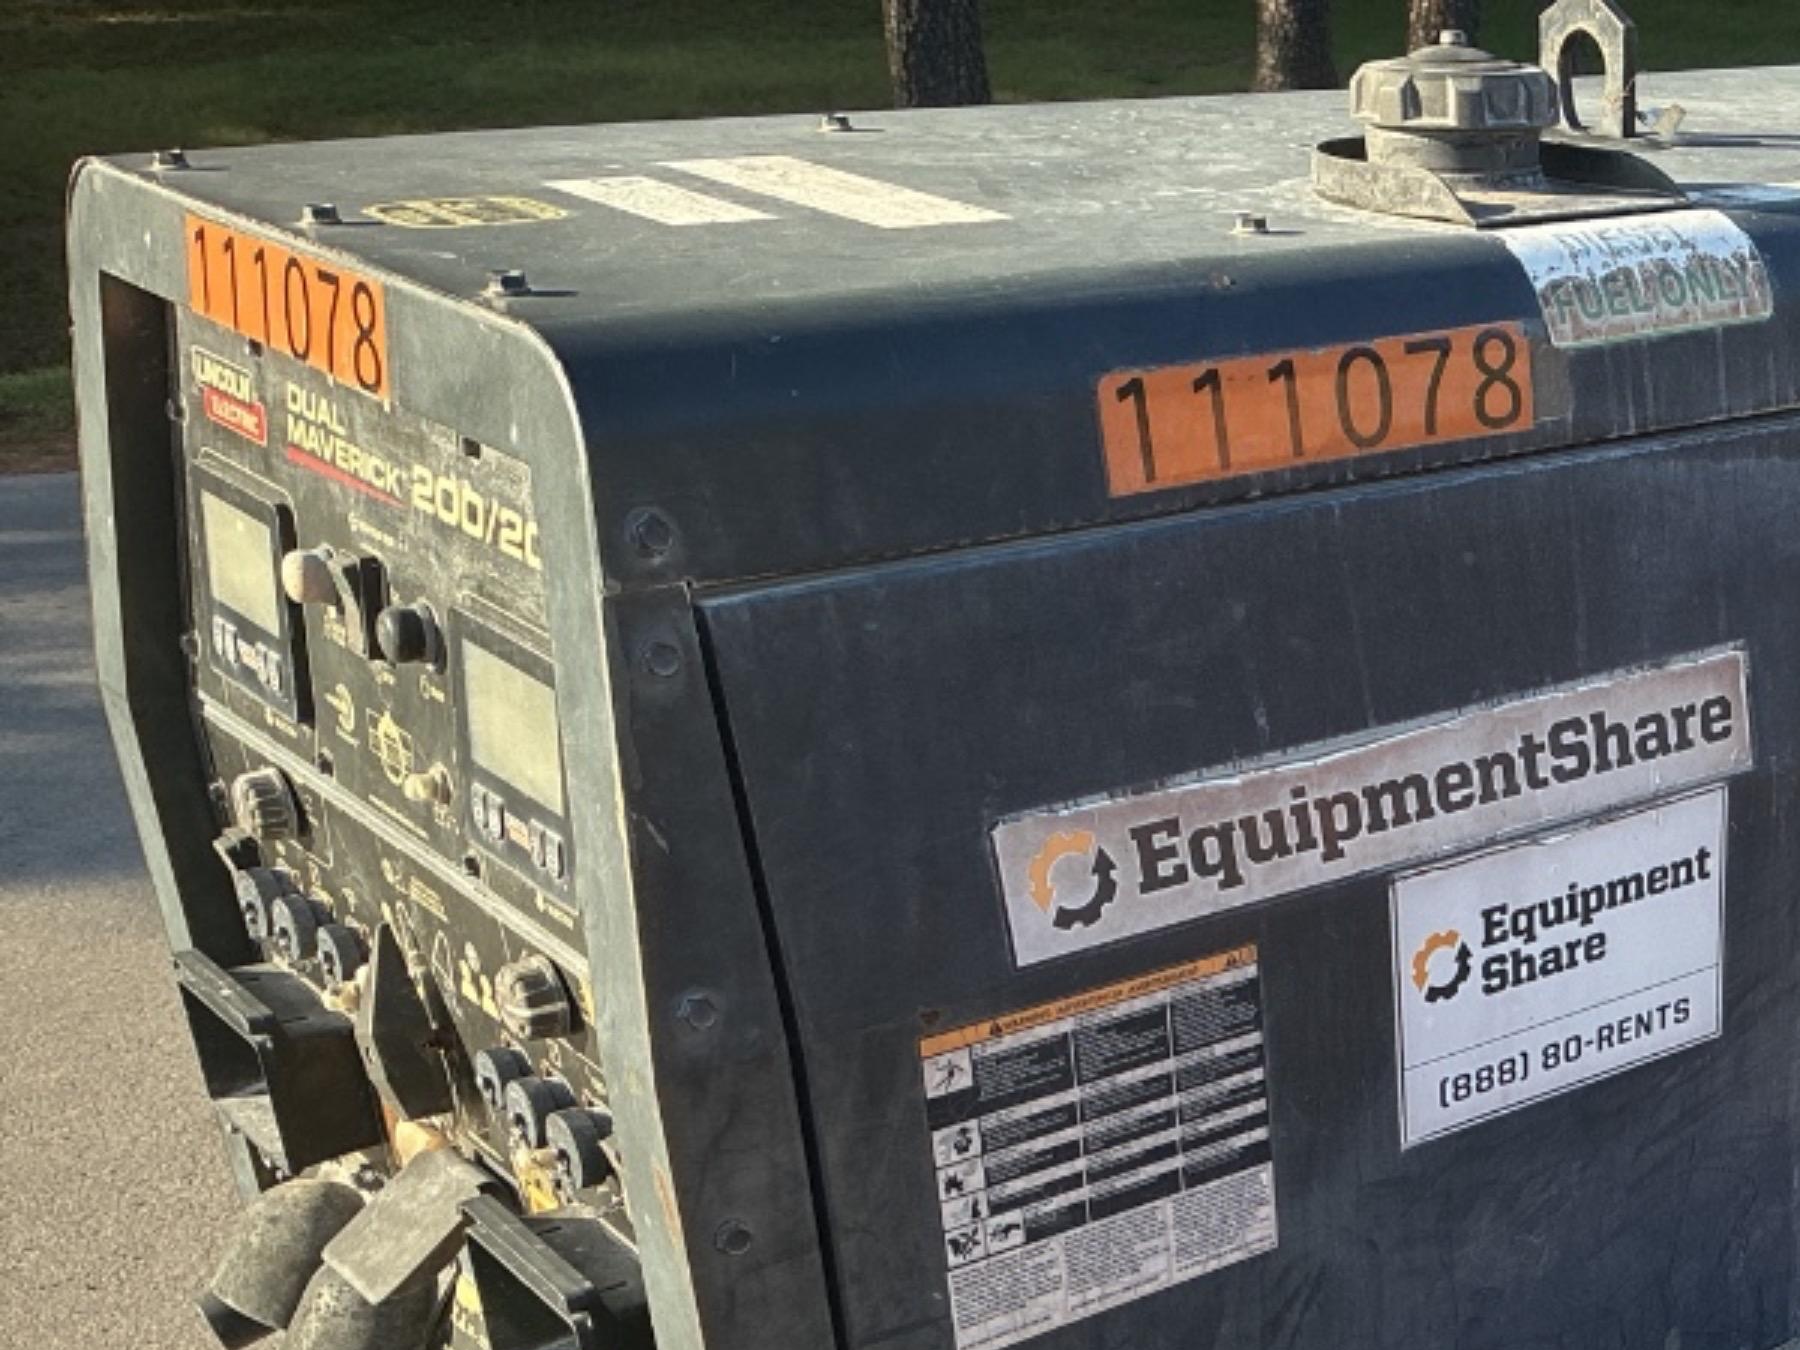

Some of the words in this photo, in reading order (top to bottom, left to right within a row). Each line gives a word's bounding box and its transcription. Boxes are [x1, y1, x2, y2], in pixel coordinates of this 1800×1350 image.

[193, 224, 383, 394] 111078
[286, 418, 402, 494] MAVERICK
[287, 382, 347, 437] DUAL
[1114, 327, 1526, 483] 111078
[1130, 695, 1733, 896] EquipmentShare
[1480, 847, 1711, 947] Equipment
[1480, 932, 1607, 996] Share
[1438, 1051, 1529, 1108] (888)
[1541, 997, 1691, 1072] 80-RENTS
